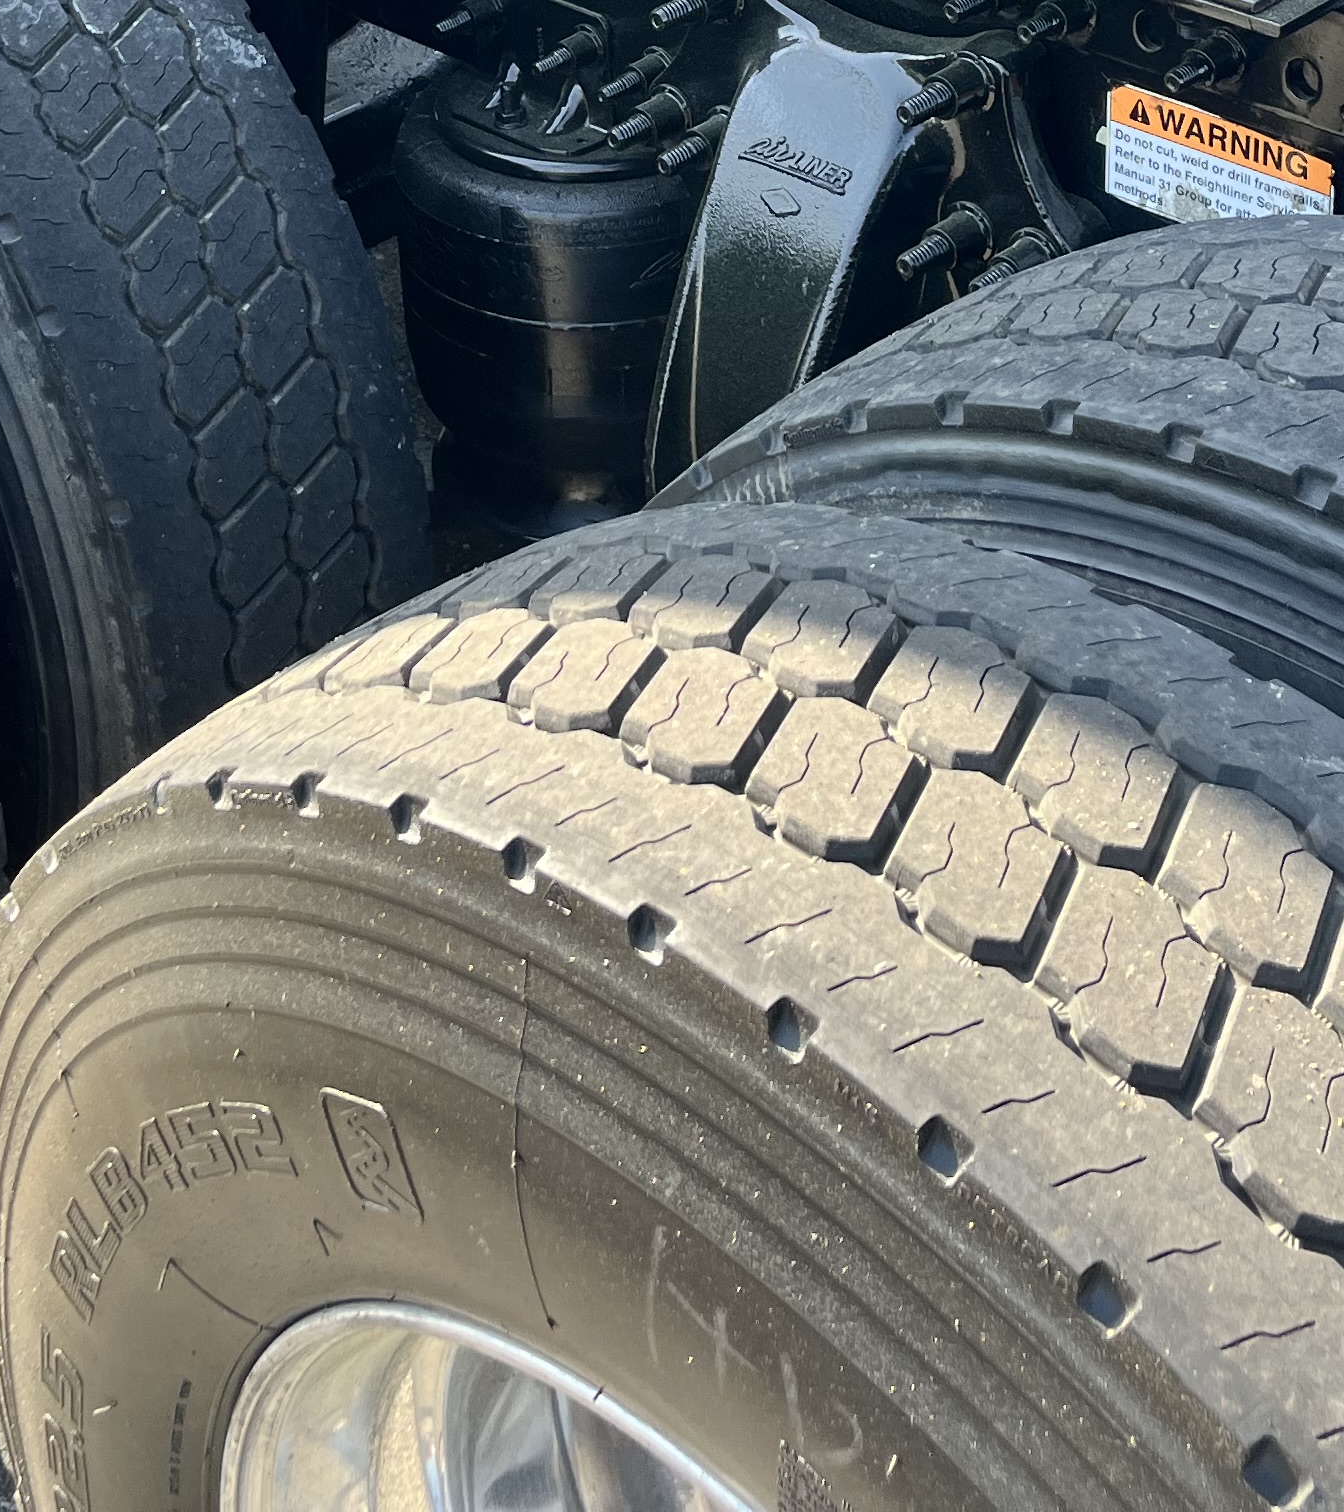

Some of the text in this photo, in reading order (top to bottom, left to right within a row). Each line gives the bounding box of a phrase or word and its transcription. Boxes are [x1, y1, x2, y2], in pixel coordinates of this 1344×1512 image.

[1115, 128, 1132, 144] Do
[1134, 136, 1154, 153] not
[1156, 144, 1178, 162] cut,
[1181, 153, 1209, 171] weld
[1212, 165, 1225, 178] or
[1228, 169, 1252, 189] drill
[1254, 176, 1290, 200] frame
[1158, 105, 1308, 180] WARNING
[1114, 162, 1156, 187] Manual
[1158, 178, 1172, 190] 31
[1175, 184, 1213, 208] Group
[1215, 198, 1233, 214] for
[1114, 181, 1167, 207] methods.
[1115, 146, 1145, 166] Refer
[1148, 158, 1161, 171] to
[1163, 162, 1183, 179] the
[1185, 170, 1254, 205] Freightliner
[50, 1101, 299, 1325] RLB452
